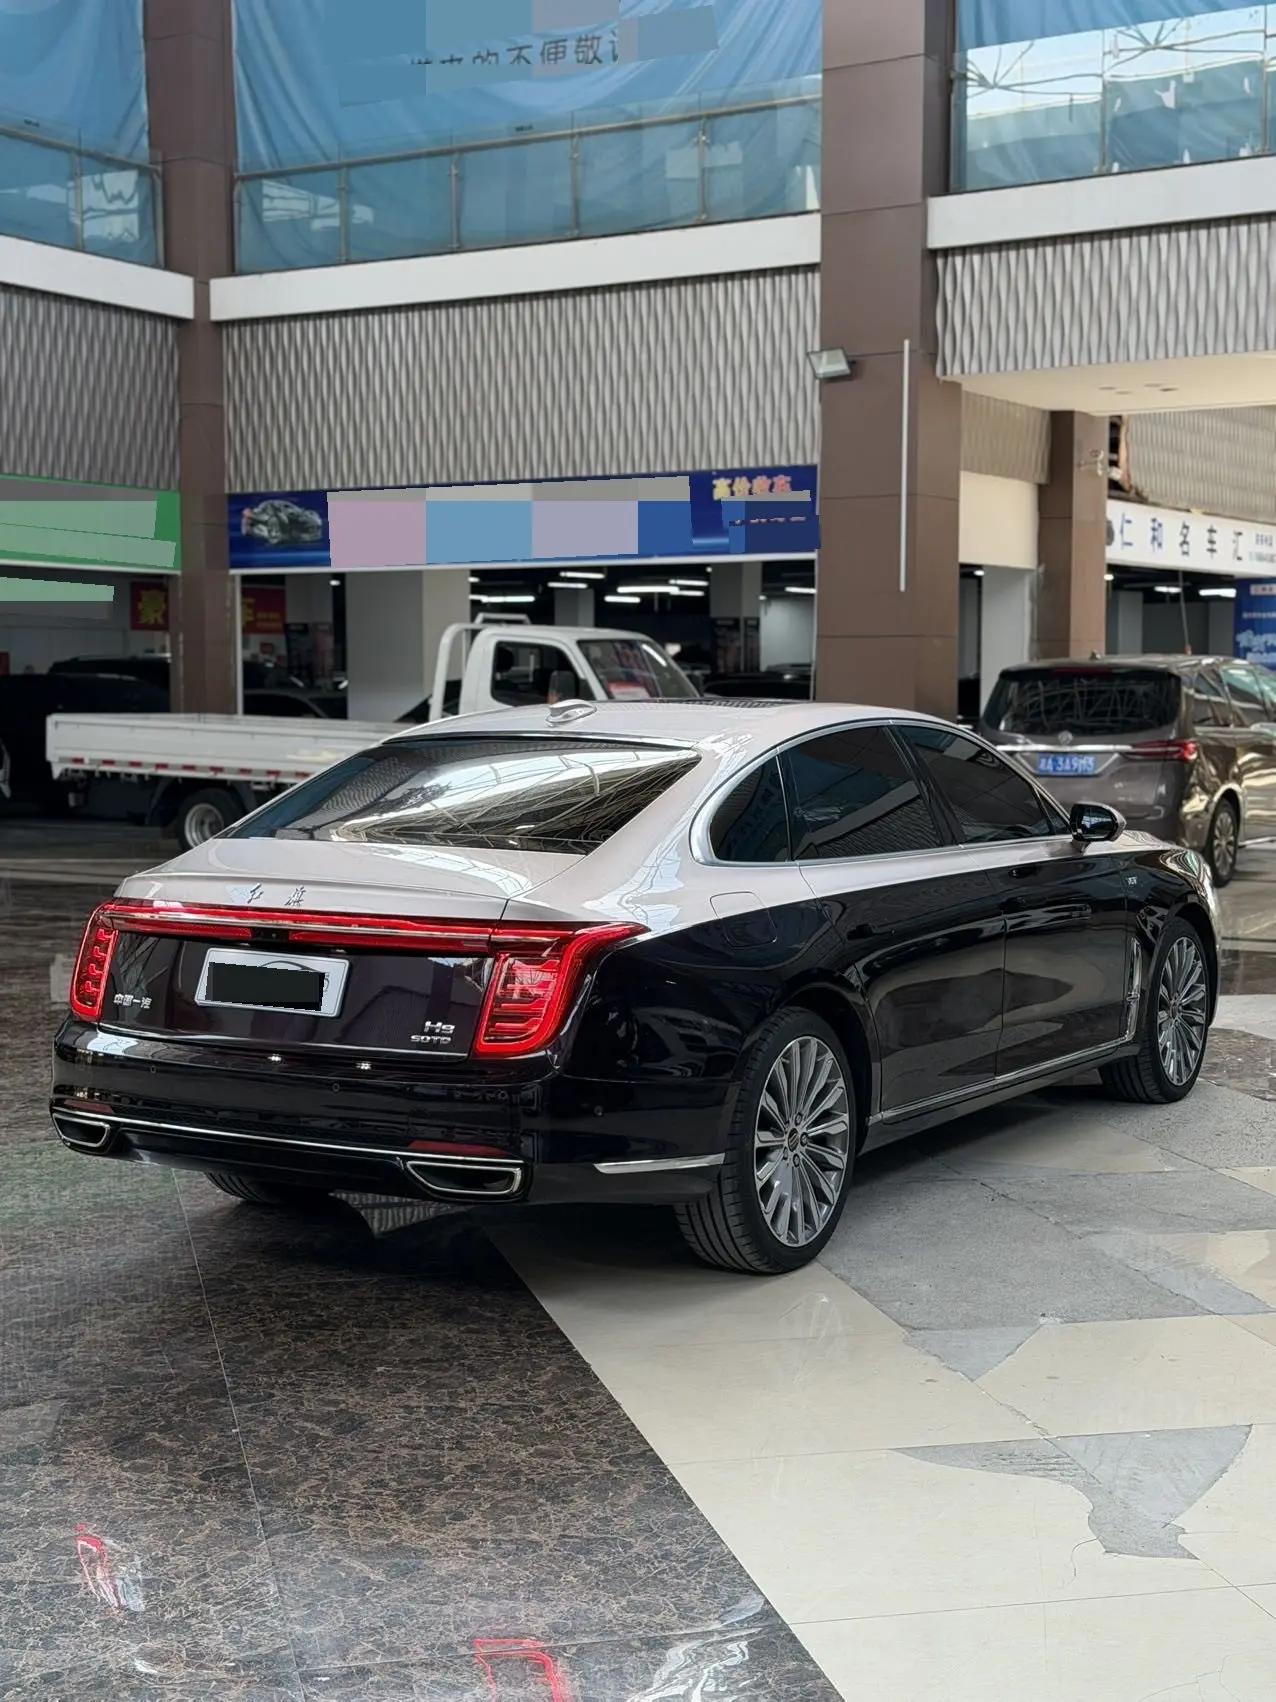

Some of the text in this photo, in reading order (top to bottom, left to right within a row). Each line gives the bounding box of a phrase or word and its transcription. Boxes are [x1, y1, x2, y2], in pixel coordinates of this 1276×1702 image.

[1119, 512, 1243, 561] 仁和名车汇
[113, 993, 153, 1009] 中国一汽
[424, 1020, 456, 1034] H9
